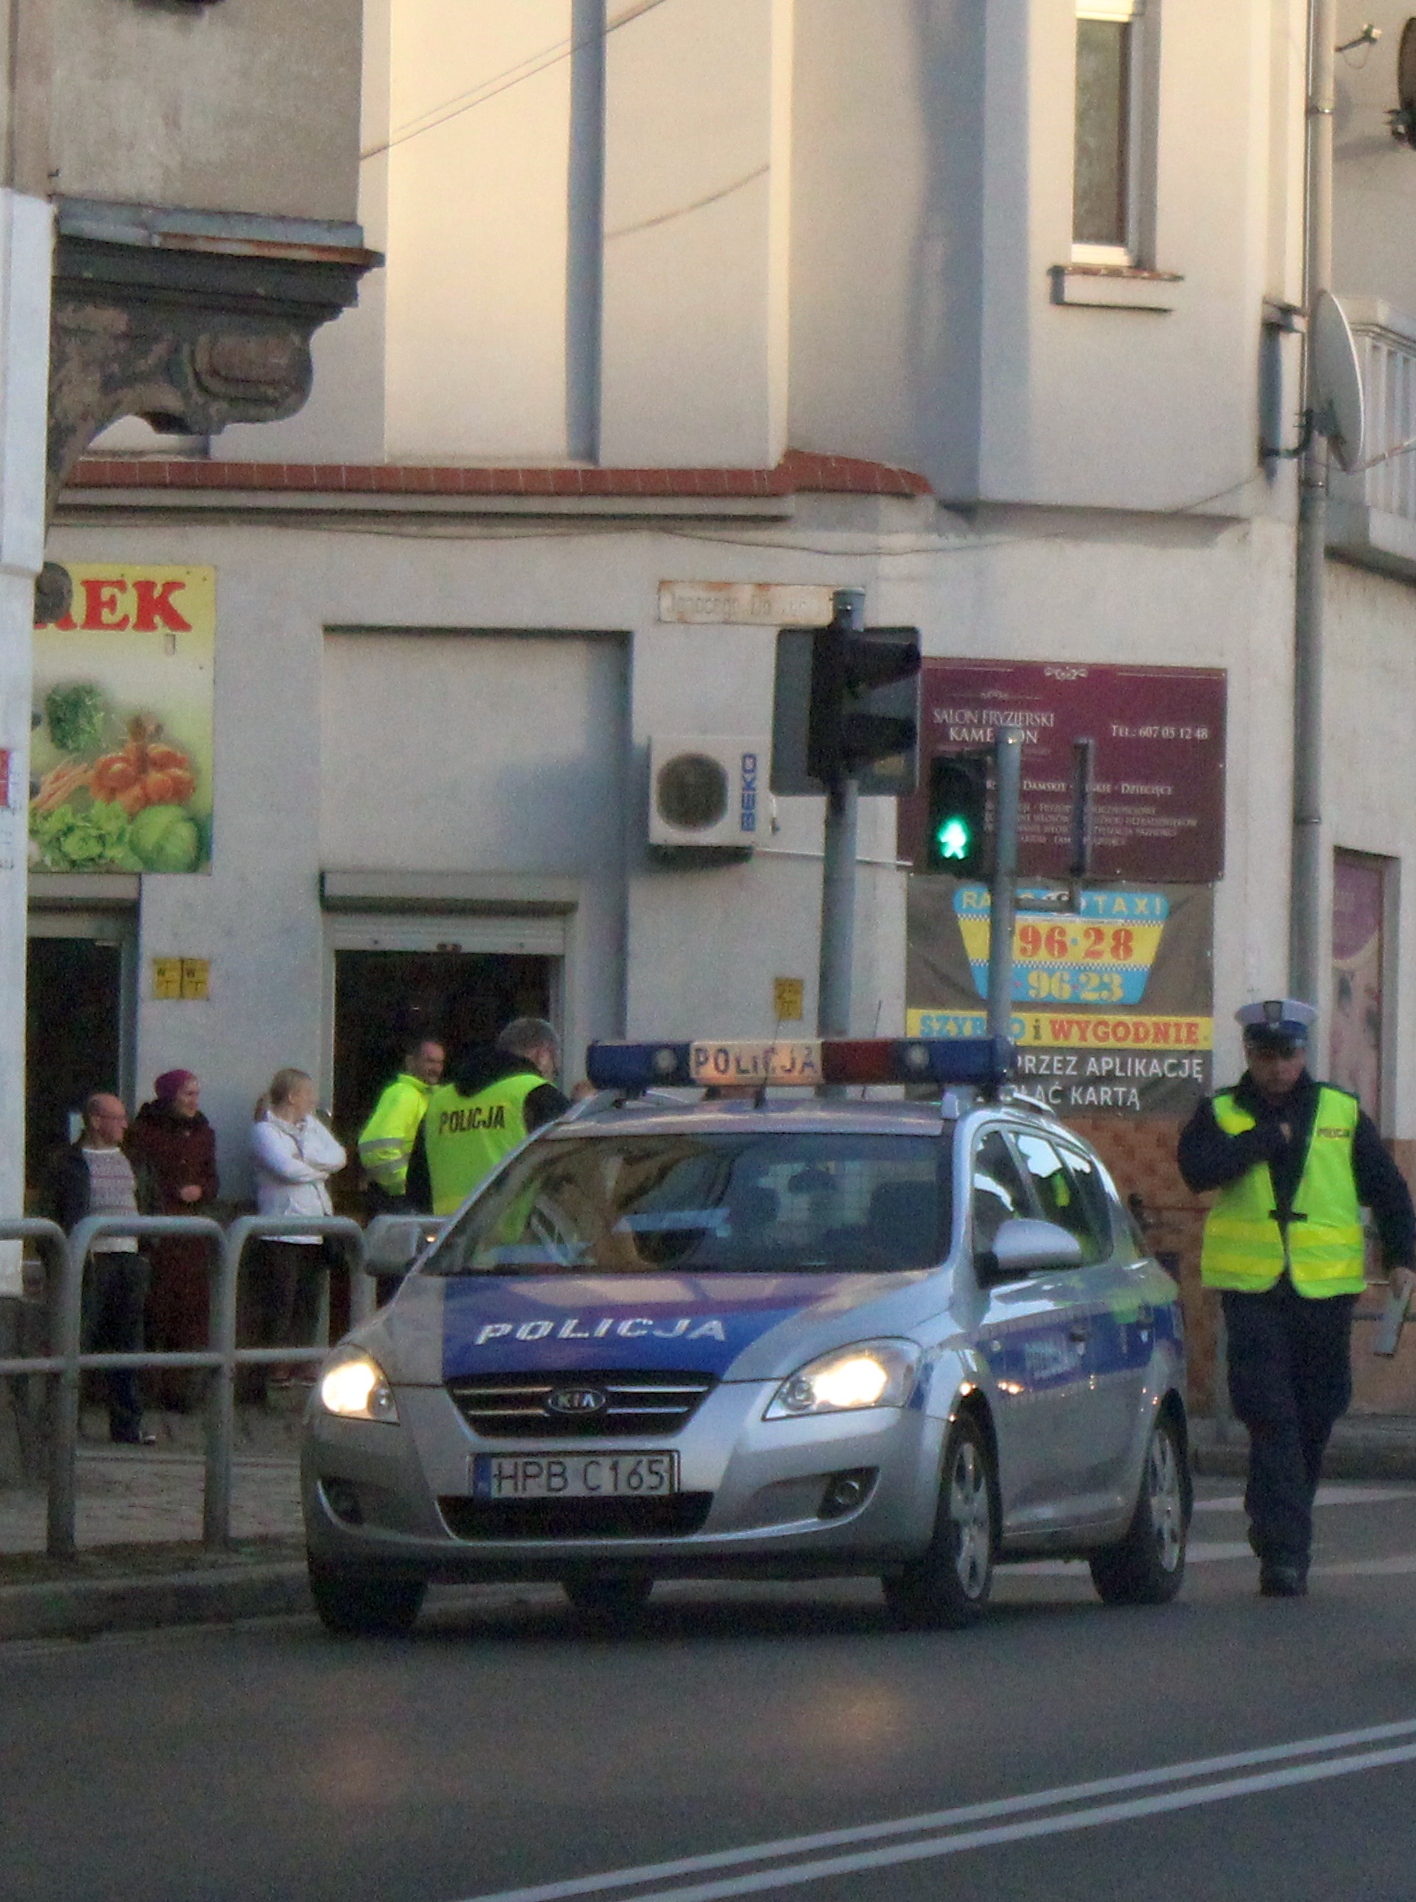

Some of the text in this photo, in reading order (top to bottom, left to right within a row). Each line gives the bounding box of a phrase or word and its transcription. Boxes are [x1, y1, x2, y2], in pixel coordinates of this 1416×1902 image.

[932, 708, 1055, 727] SALON FRYZIERSKI
[1094, 896, 1162, 917] TAXI
[1033, 1018, 1042, 1041] i
[694, 1046, 818, 1077] POLICJA
[1086, 1056, 1204, 1082] APLIKACJĘ
[1070, 1087, 1140, 1111] KARTĄ
[439, 1105, 505, 1134] POLICJA
[474, 1317, 726, 1346] POLICJA
[558, 1394, 597, 1408] KIA
[493, 1458, 665, 1494] HPB C165
